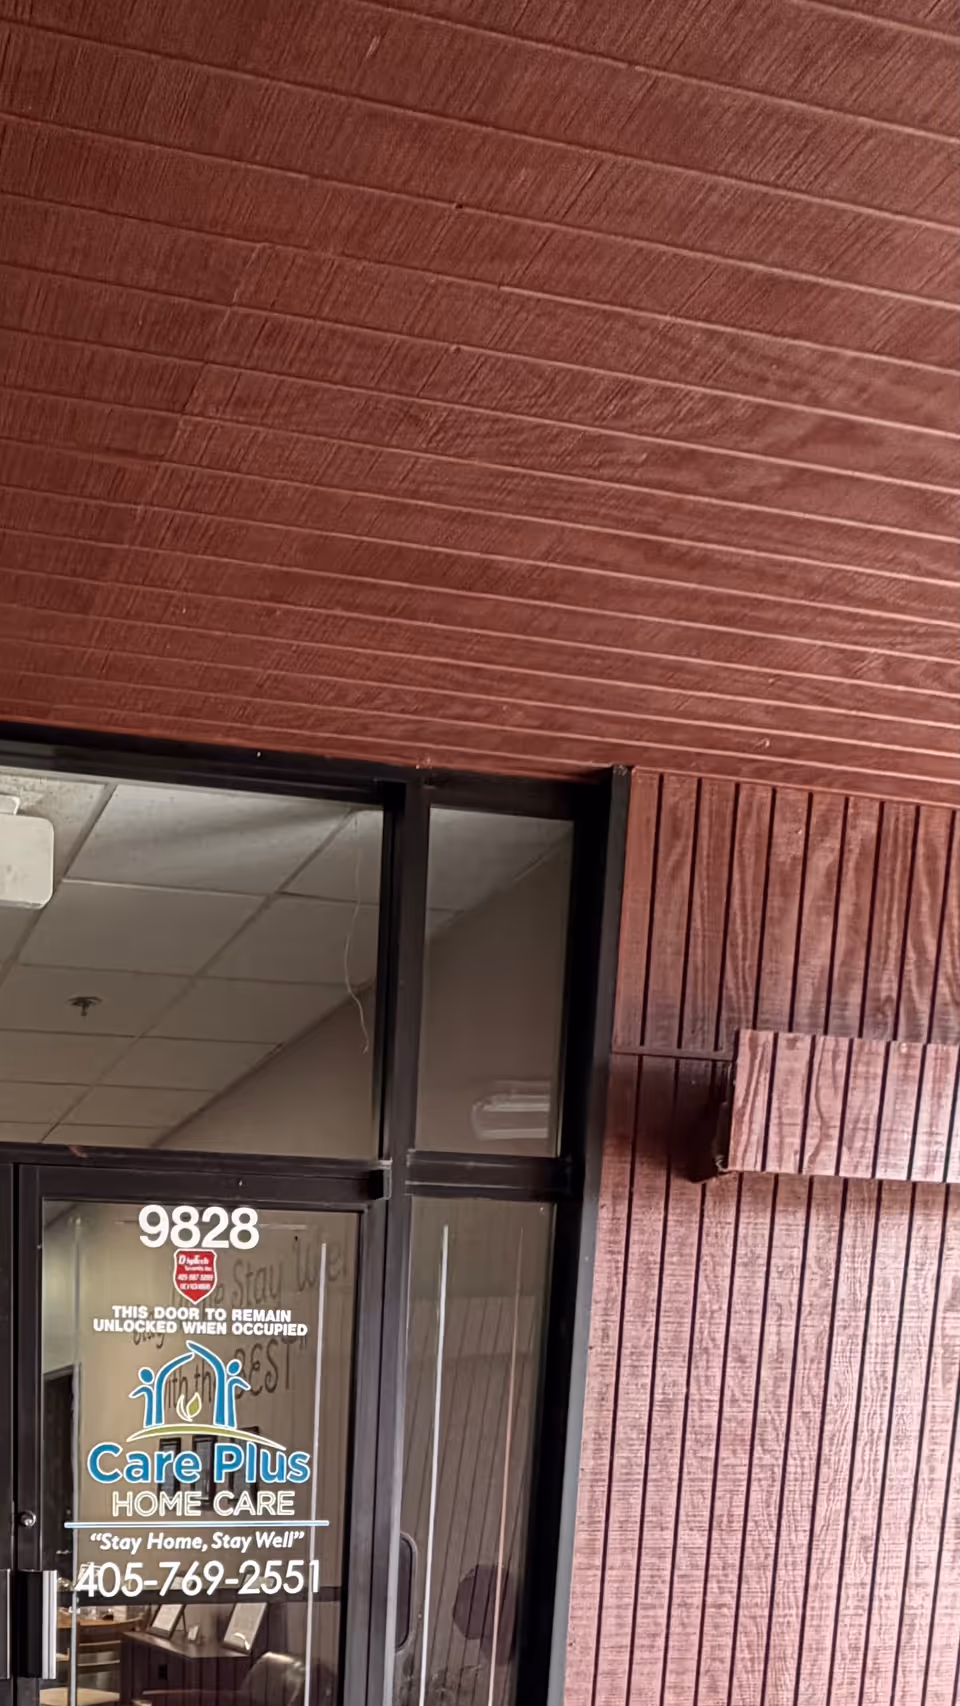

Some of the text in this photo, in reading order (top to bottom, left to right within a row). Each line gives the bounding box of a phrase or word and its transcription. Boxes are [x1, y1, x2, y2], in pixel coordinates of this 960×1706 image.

[138, 1204, 260, 1250] 9828
[93, 1318, 309, 1337] UNLOCKED WHEN OCCUPIED
[112, 1305, 292, 1323] THIS DOOR TO REMAIN
[87, 1441, 311, 1484] Care Plus
[112, 1490, 296, 1517] HOME CARE
[147, 1532, 208, 1552] Home,
[211, 1532, 252, 1555] Stay
[74, 1559, 320, 1598] 405-769-2551
